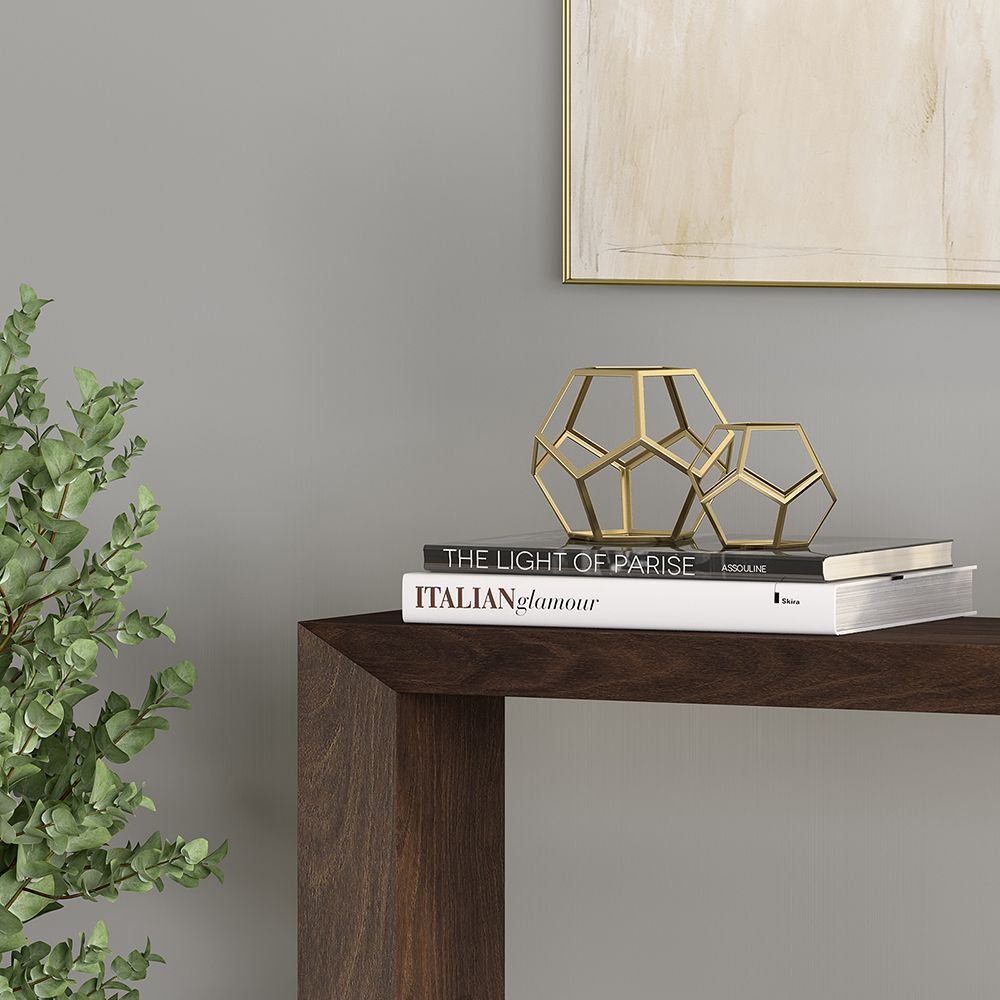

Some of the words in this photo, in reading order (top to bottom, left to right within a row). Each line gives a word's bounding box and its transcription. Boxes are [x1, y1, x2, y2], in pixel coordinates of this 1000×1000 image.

[443, 548, 489, 569] THE
[497, 549, 568, 571] LIGHT
[573, 552, 607, 573] OF
[614, 554, 696, 577] PARISE
[721, 563, 767, 574] ASSOULINE
[781, 597, 801, 606] Skira
